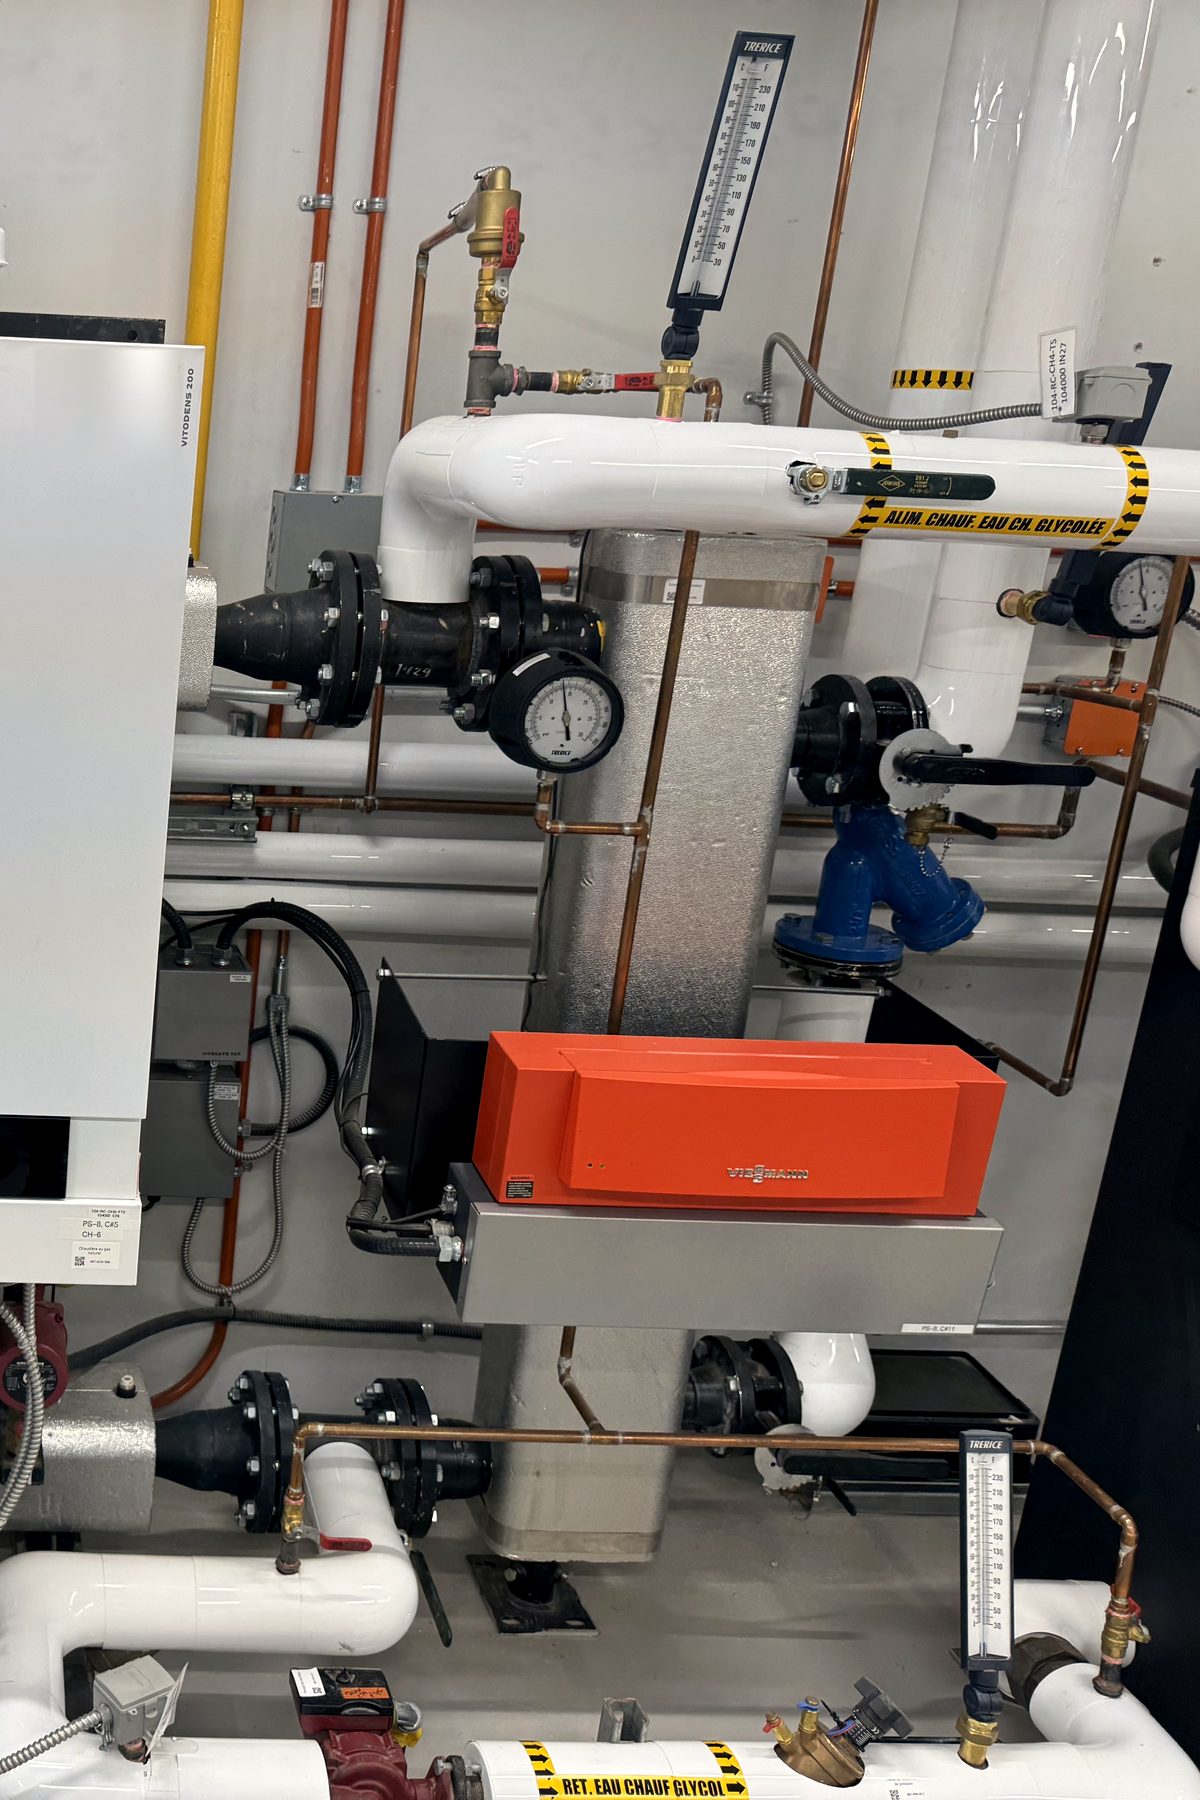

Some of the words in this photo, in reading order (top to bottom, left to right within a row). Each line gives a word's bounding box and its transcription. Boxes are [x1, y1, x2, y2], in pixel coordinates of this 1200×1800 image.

[743, 41, 783, 53] TRERICE
[764, 64, 769, 72] F
[758, 85, 771, 94] 230
[754, 104, 766, 112] 210
[750, 121, 761, 129] 190
[745, 139, 756, 147] 170
[741, 157, 752, 165] 150
[736, 174, 747, 182] 130
[726, 208, 735, 216] 90
[722, 225, 730, 233] 70
[717, 242, 726, 250] 50
[713, 258, 722, 266] 30
[1059, 342, 1067, 365] IN27
[186, 368, 195, 389] 200
[1049, 339, 1058, 411] 104-RC-CH4-TS
[1059, 368, 1068, 404] 104000
[181, 393, 192, 447] VITODENS
[884, 511, 921, 525] ALIM.
[925, 512, 975, 528] CHAUF.
[977, 515, 1006, 530] EAU
[1008, 517, 1031, 531] CH.
[1034, 517, 1107, 534] GLYCOLÉE
[726, 1164, 809, 1183] VIESSMANN
[82, 1220, 103, 1228] PS-8,
[969, 1440, 1003, 1449] TRERICE
[992, 1474, 1003, 1482] 230
[993, 1503, 1003, 1511] 190
[993, 1518, 1003, 1526] 170
[993, 1533, 1003, 1541] 150
[993, 1562, 1003, 1570] 110
[993, 1577, 1001, 1585] 90
[562, 1778, 592, 1795] RET.
[594, 1779, 622, 1795] EAU
[623, 1779, 670, 1796] CHAUF
[673, 1780, 726, 1797] GLYCOL
